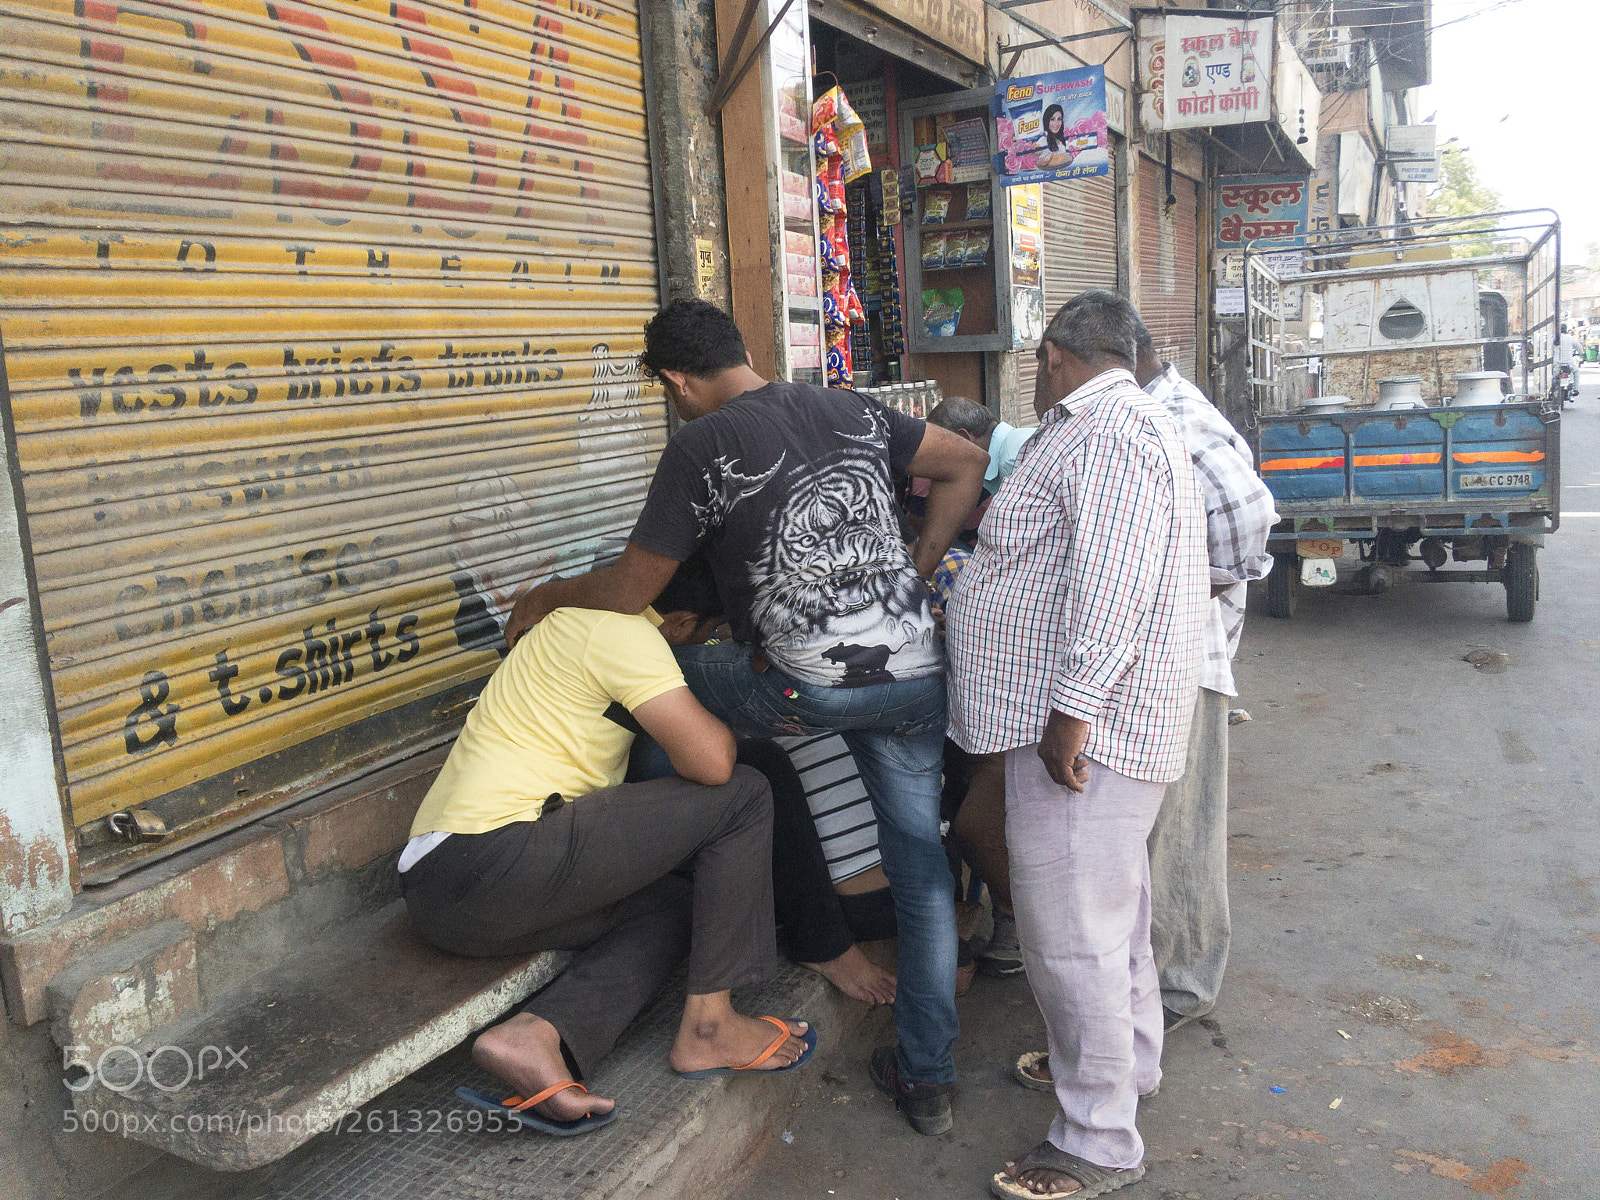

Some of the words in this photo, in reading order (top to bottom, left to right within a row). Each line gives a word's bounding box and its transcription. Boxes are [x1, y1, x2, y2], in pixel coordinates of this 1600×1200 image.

[1180, 34, 1226, 59] स्कूल
[1227, 27, 1260, 48] बैग
[1205, 63, 1232, 84] एण्ड
[1007, 85, 1034, 102] Fena
[1036, 78, 1093, 95] SUPERWASH
[1177, 90, 1217, 116] फोटो
[1218, 85, 1260, 112] कॉपी
[1018, 119, 1040, 134] Fena
[1072, 167, 1081, 176] ही
[1221, 181, 1305, 214] स्कूल
[68, 350, 258, 418] vests
[283, 342, 422, 402] briefs
[437, 341, 563, 389] trunks
[1506, 474, 1530, 487] 9748
[124, 670, 180, 755] &
